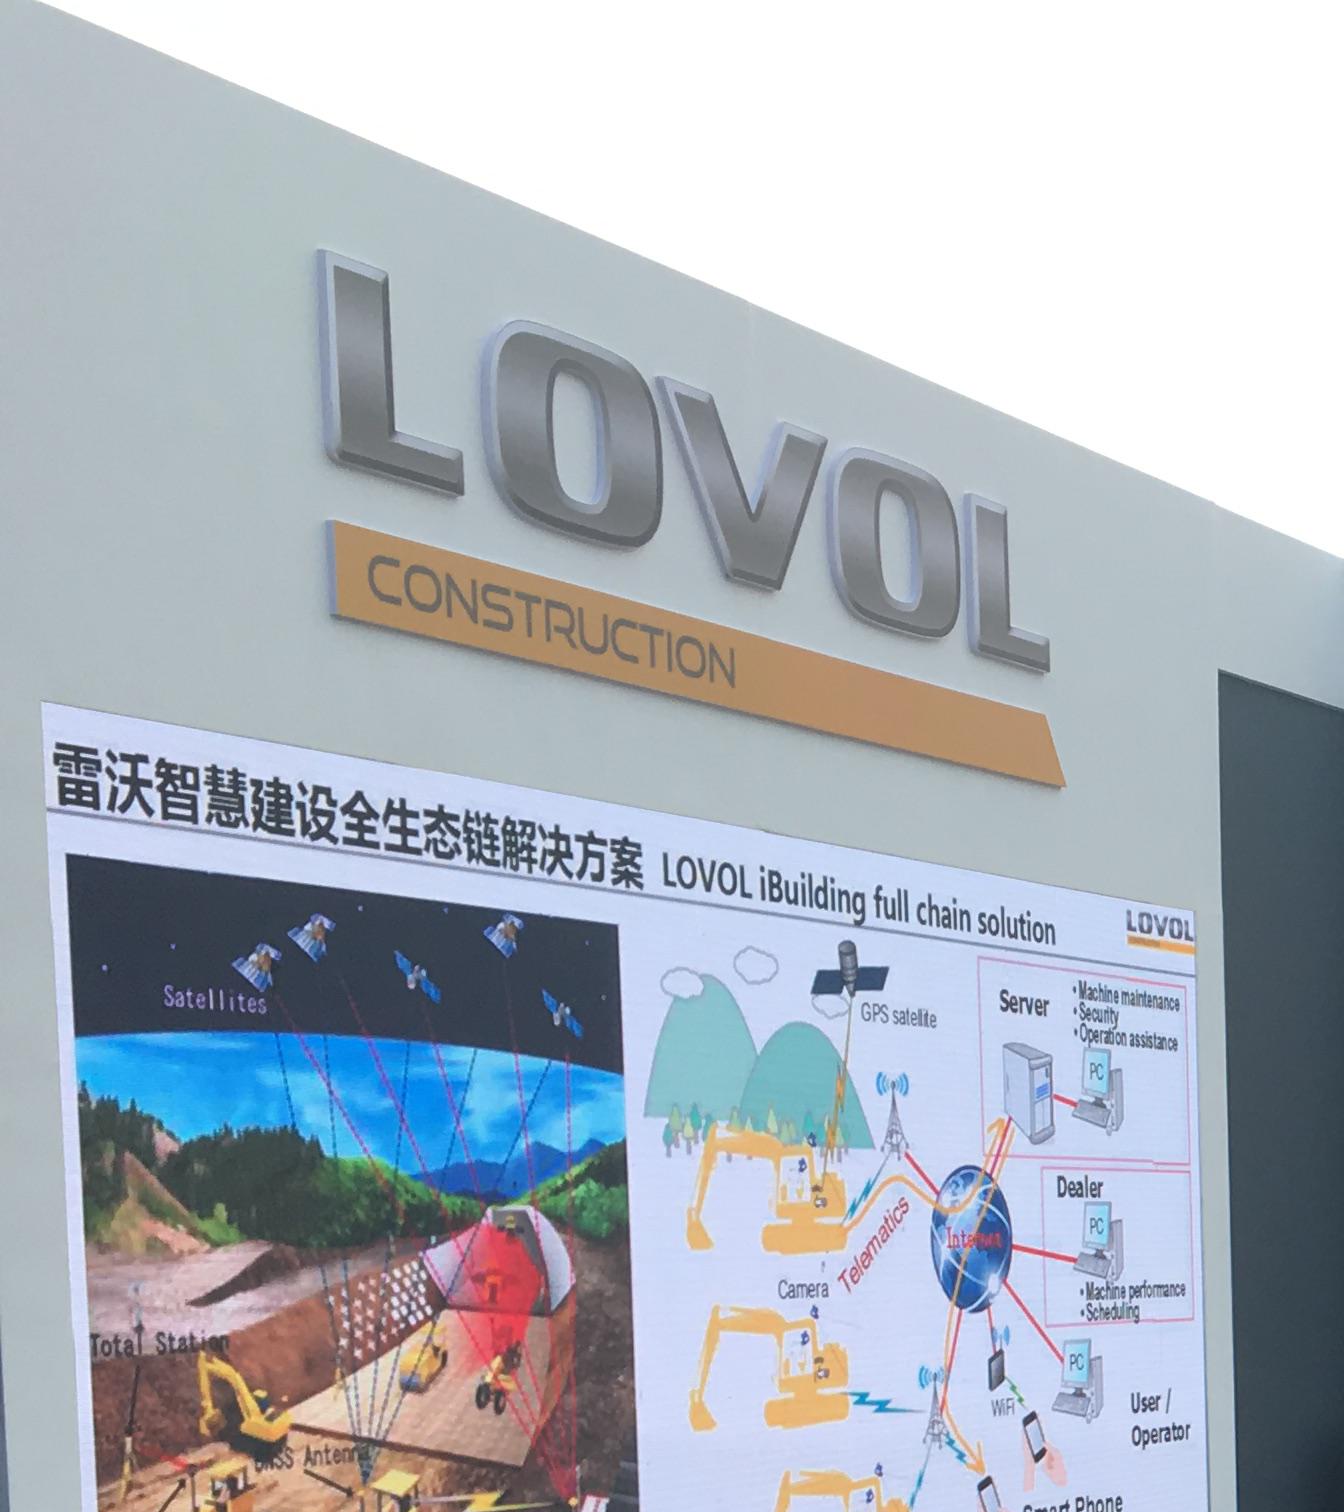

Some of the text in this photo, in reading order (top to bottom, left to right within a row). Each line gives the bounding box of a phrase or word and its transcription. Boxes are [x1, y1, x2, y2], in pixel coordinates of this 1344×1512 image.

[317, 248, 1052, 673] LOVOL
[368, 555, 735, 688] CONSTRUCTION
[53, 742, 1056, 945] 雷沃智慧建设全生态链解决方案 LOVOL iBuilding full chain solution
[1126, 909, 1194, 941] LOVOL
[164, 985, 267, 1014] Satellites
[1000, 989, 1049, 1017] Server
[1078, 980, 1181, 1012] Machine maintenance
[861, 1002, 937, 1028] GPS satellite
[1080, 1002, 1119, 1029] Security
[1080, 1023, 1178, 1051] Operation assistance
[1090, 1063, 1104, 1081] PC
[1057, 1175, 1103, 1198] Dealer
[1090, 1217, 1104, 1235] PC
[837, 1196, 909, 1294] Telematics
[778, 1280, 829, 1300] Camera
[1086, 1280, 1186, 1303] Machine performance
[1086, 1301, 1140, 1323] Scheduling
[1070, 1354, 1084, 1371] PC
[992, 1398, 1015, 1416] WiFi
[1130, 1392, 1160, 1414] User
[1131, 1422, 1191, 1449] Operator
